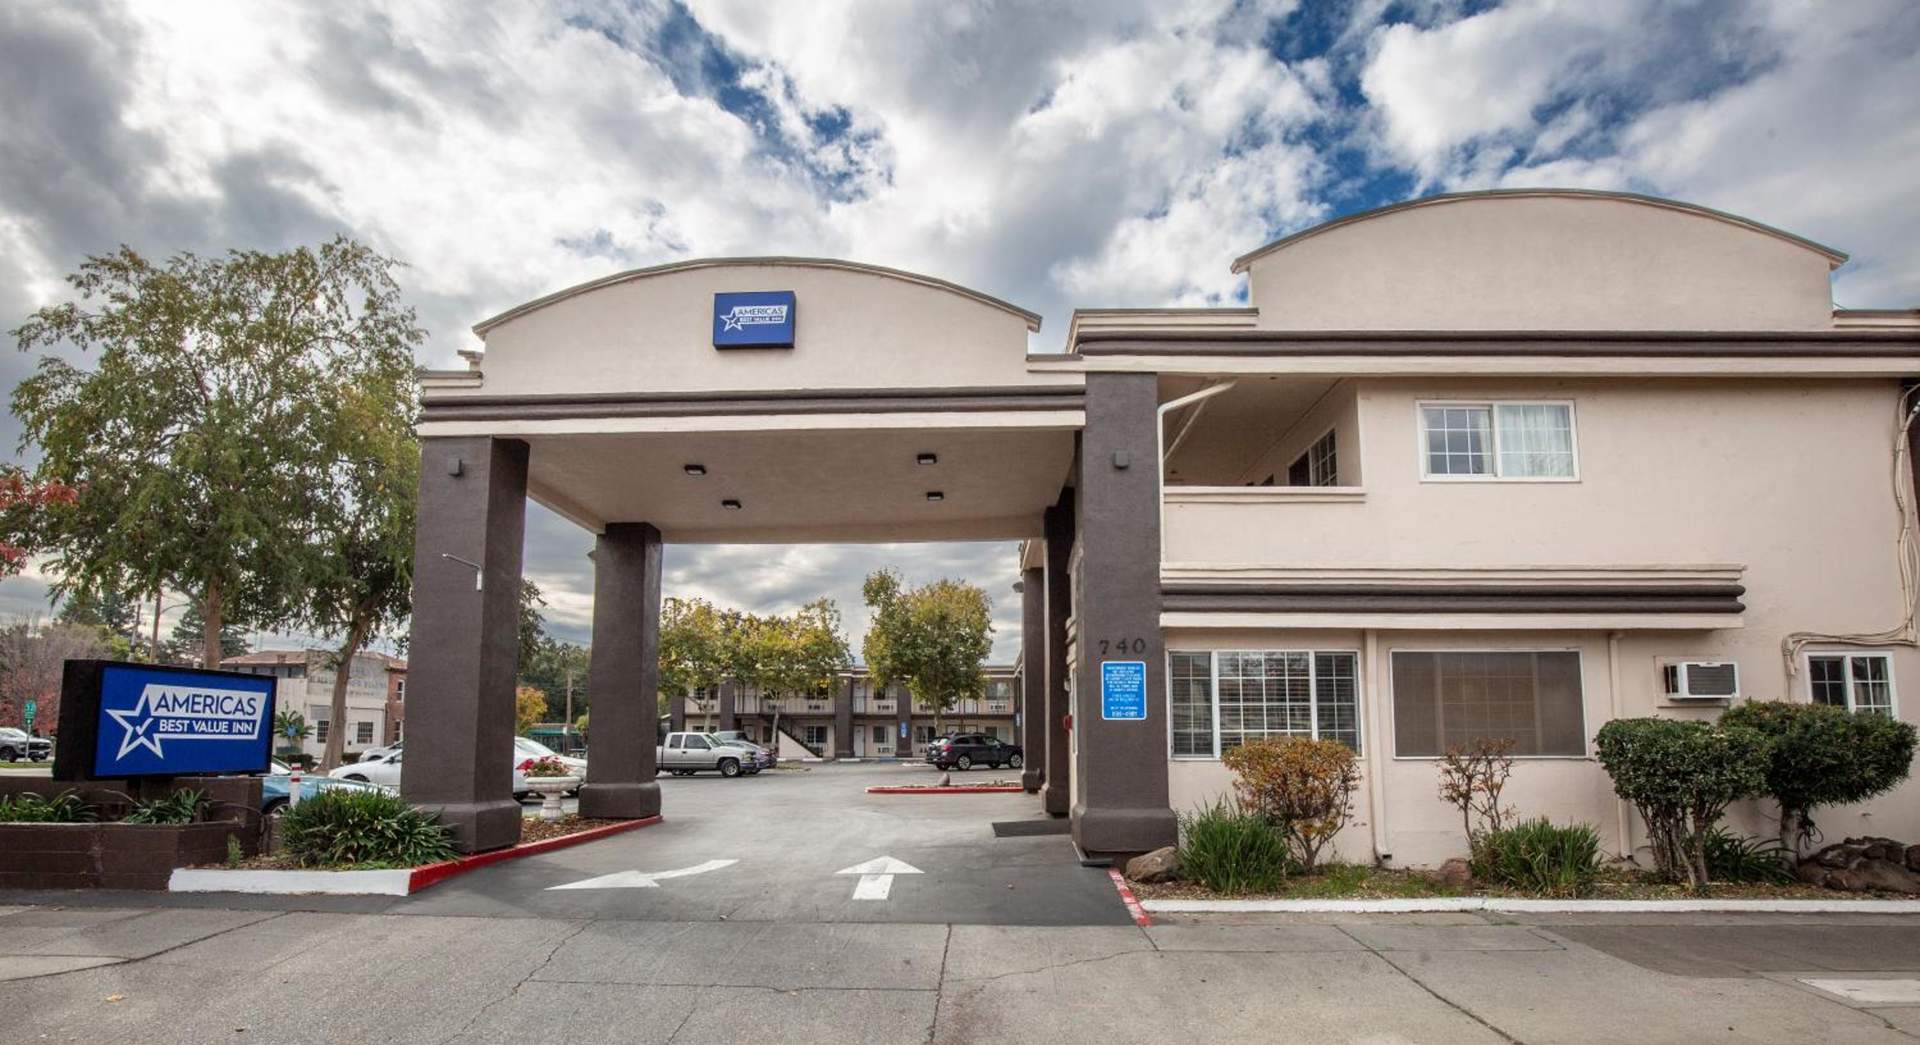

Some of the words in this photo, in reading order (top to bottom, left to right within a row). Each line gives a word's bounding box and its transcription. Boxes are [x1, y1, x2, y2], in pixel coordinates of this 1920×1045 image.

[738, 307, 784, 316] AMERICAS
[1098, 638, 1146, 655] 740
[154, 691, 257, 716] AMERICAS
[159, 718, 190, 732] BEST
[192, 720, 229, 733] VALUE
[232, 721, 253, 733] INN
